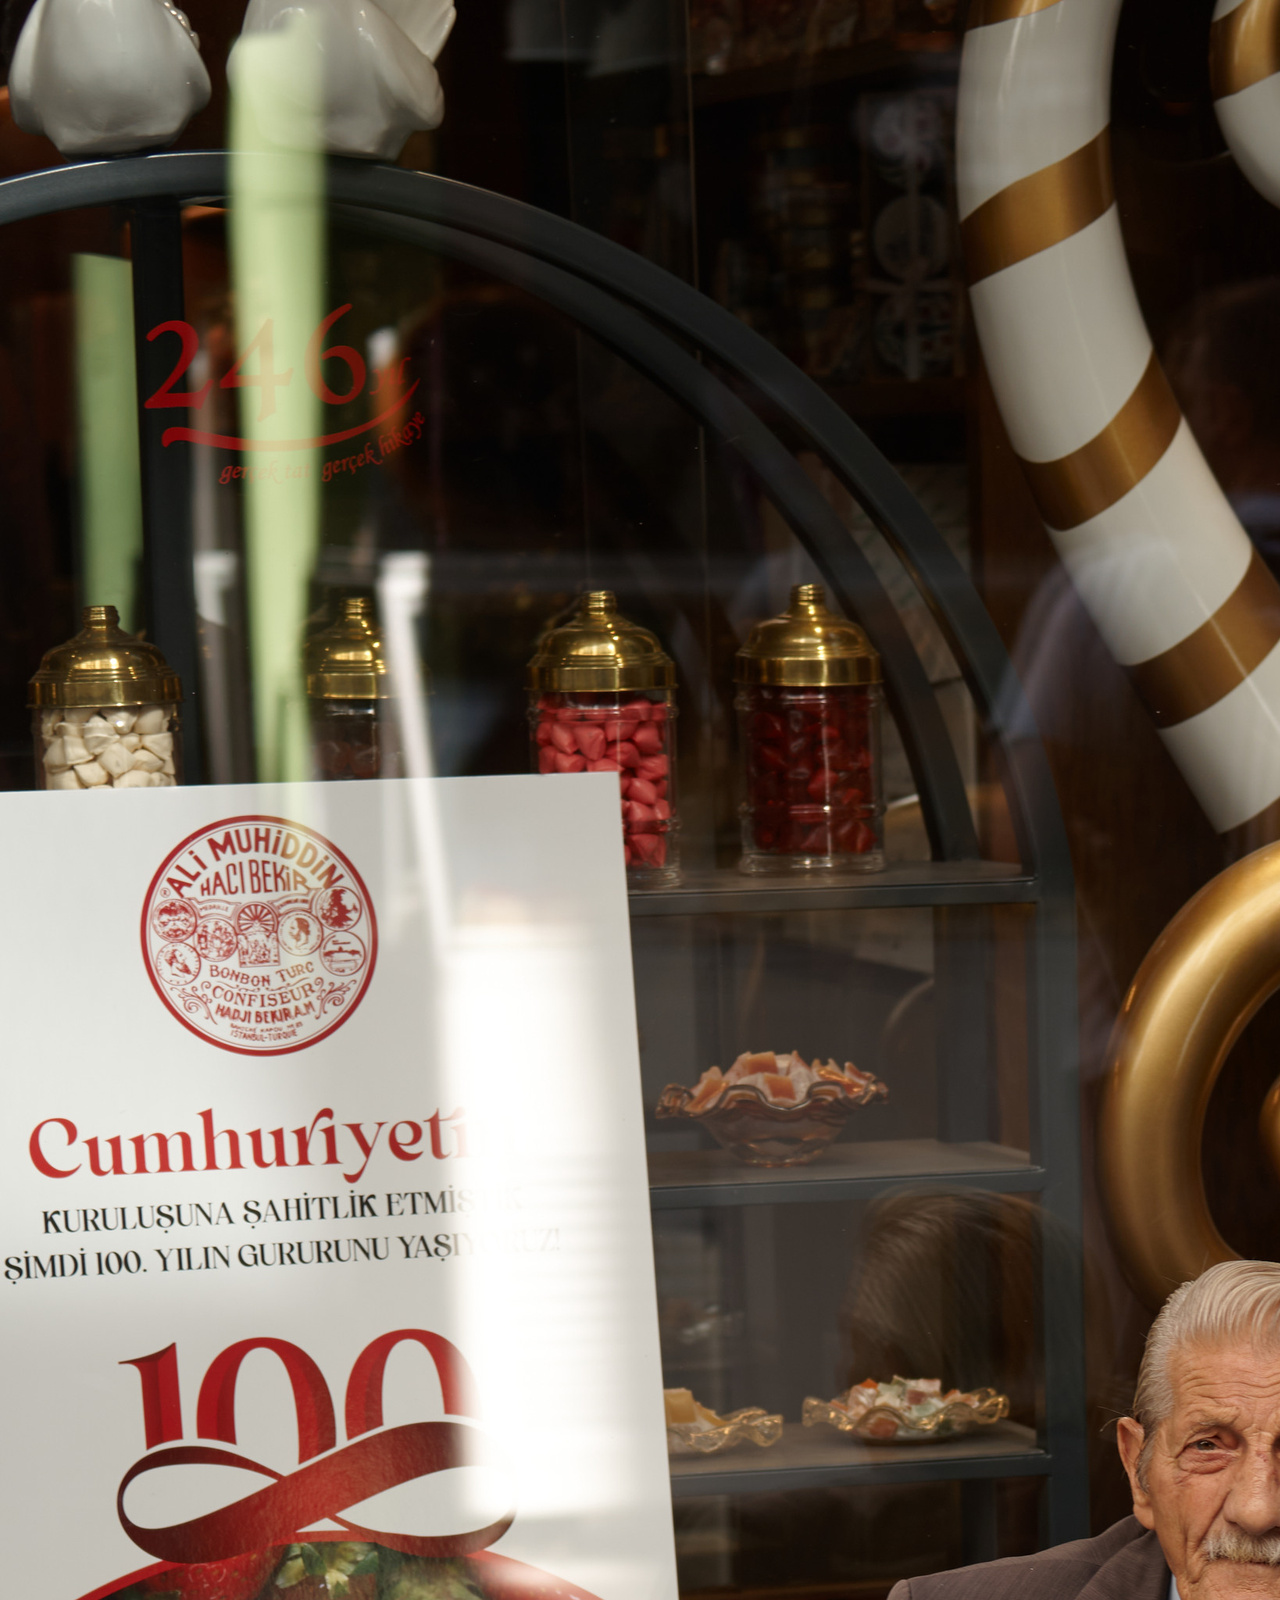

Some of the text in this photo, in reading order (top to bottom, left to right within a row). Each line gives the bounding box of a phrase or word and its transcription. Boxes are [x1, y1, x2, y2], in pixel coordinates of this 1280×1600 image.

[144, 303, 366, 422] 246
[322, 442, 383, 482] gerçek
[201, 861, 246, 896] HACI
[210, 960, 314, 987] BONBON TURC
[213, 982, 316, 1008] CONFISEUR
[215, 1003, 252, 1023] HADJI
[42, 1202, 234, 1233] KURULUŞUNA
[243, 1190, 377, 1229] ŞAHİTLİK
[4, 1247, 88, 1285] ŞİMDİ
[96, 1250, 148, 1275] 100.
[155, 1244, 230, 1272] YILIN
[237, 1234, 390, 1269] GURURUNU
[118, 1328, 484, 1465] 100
